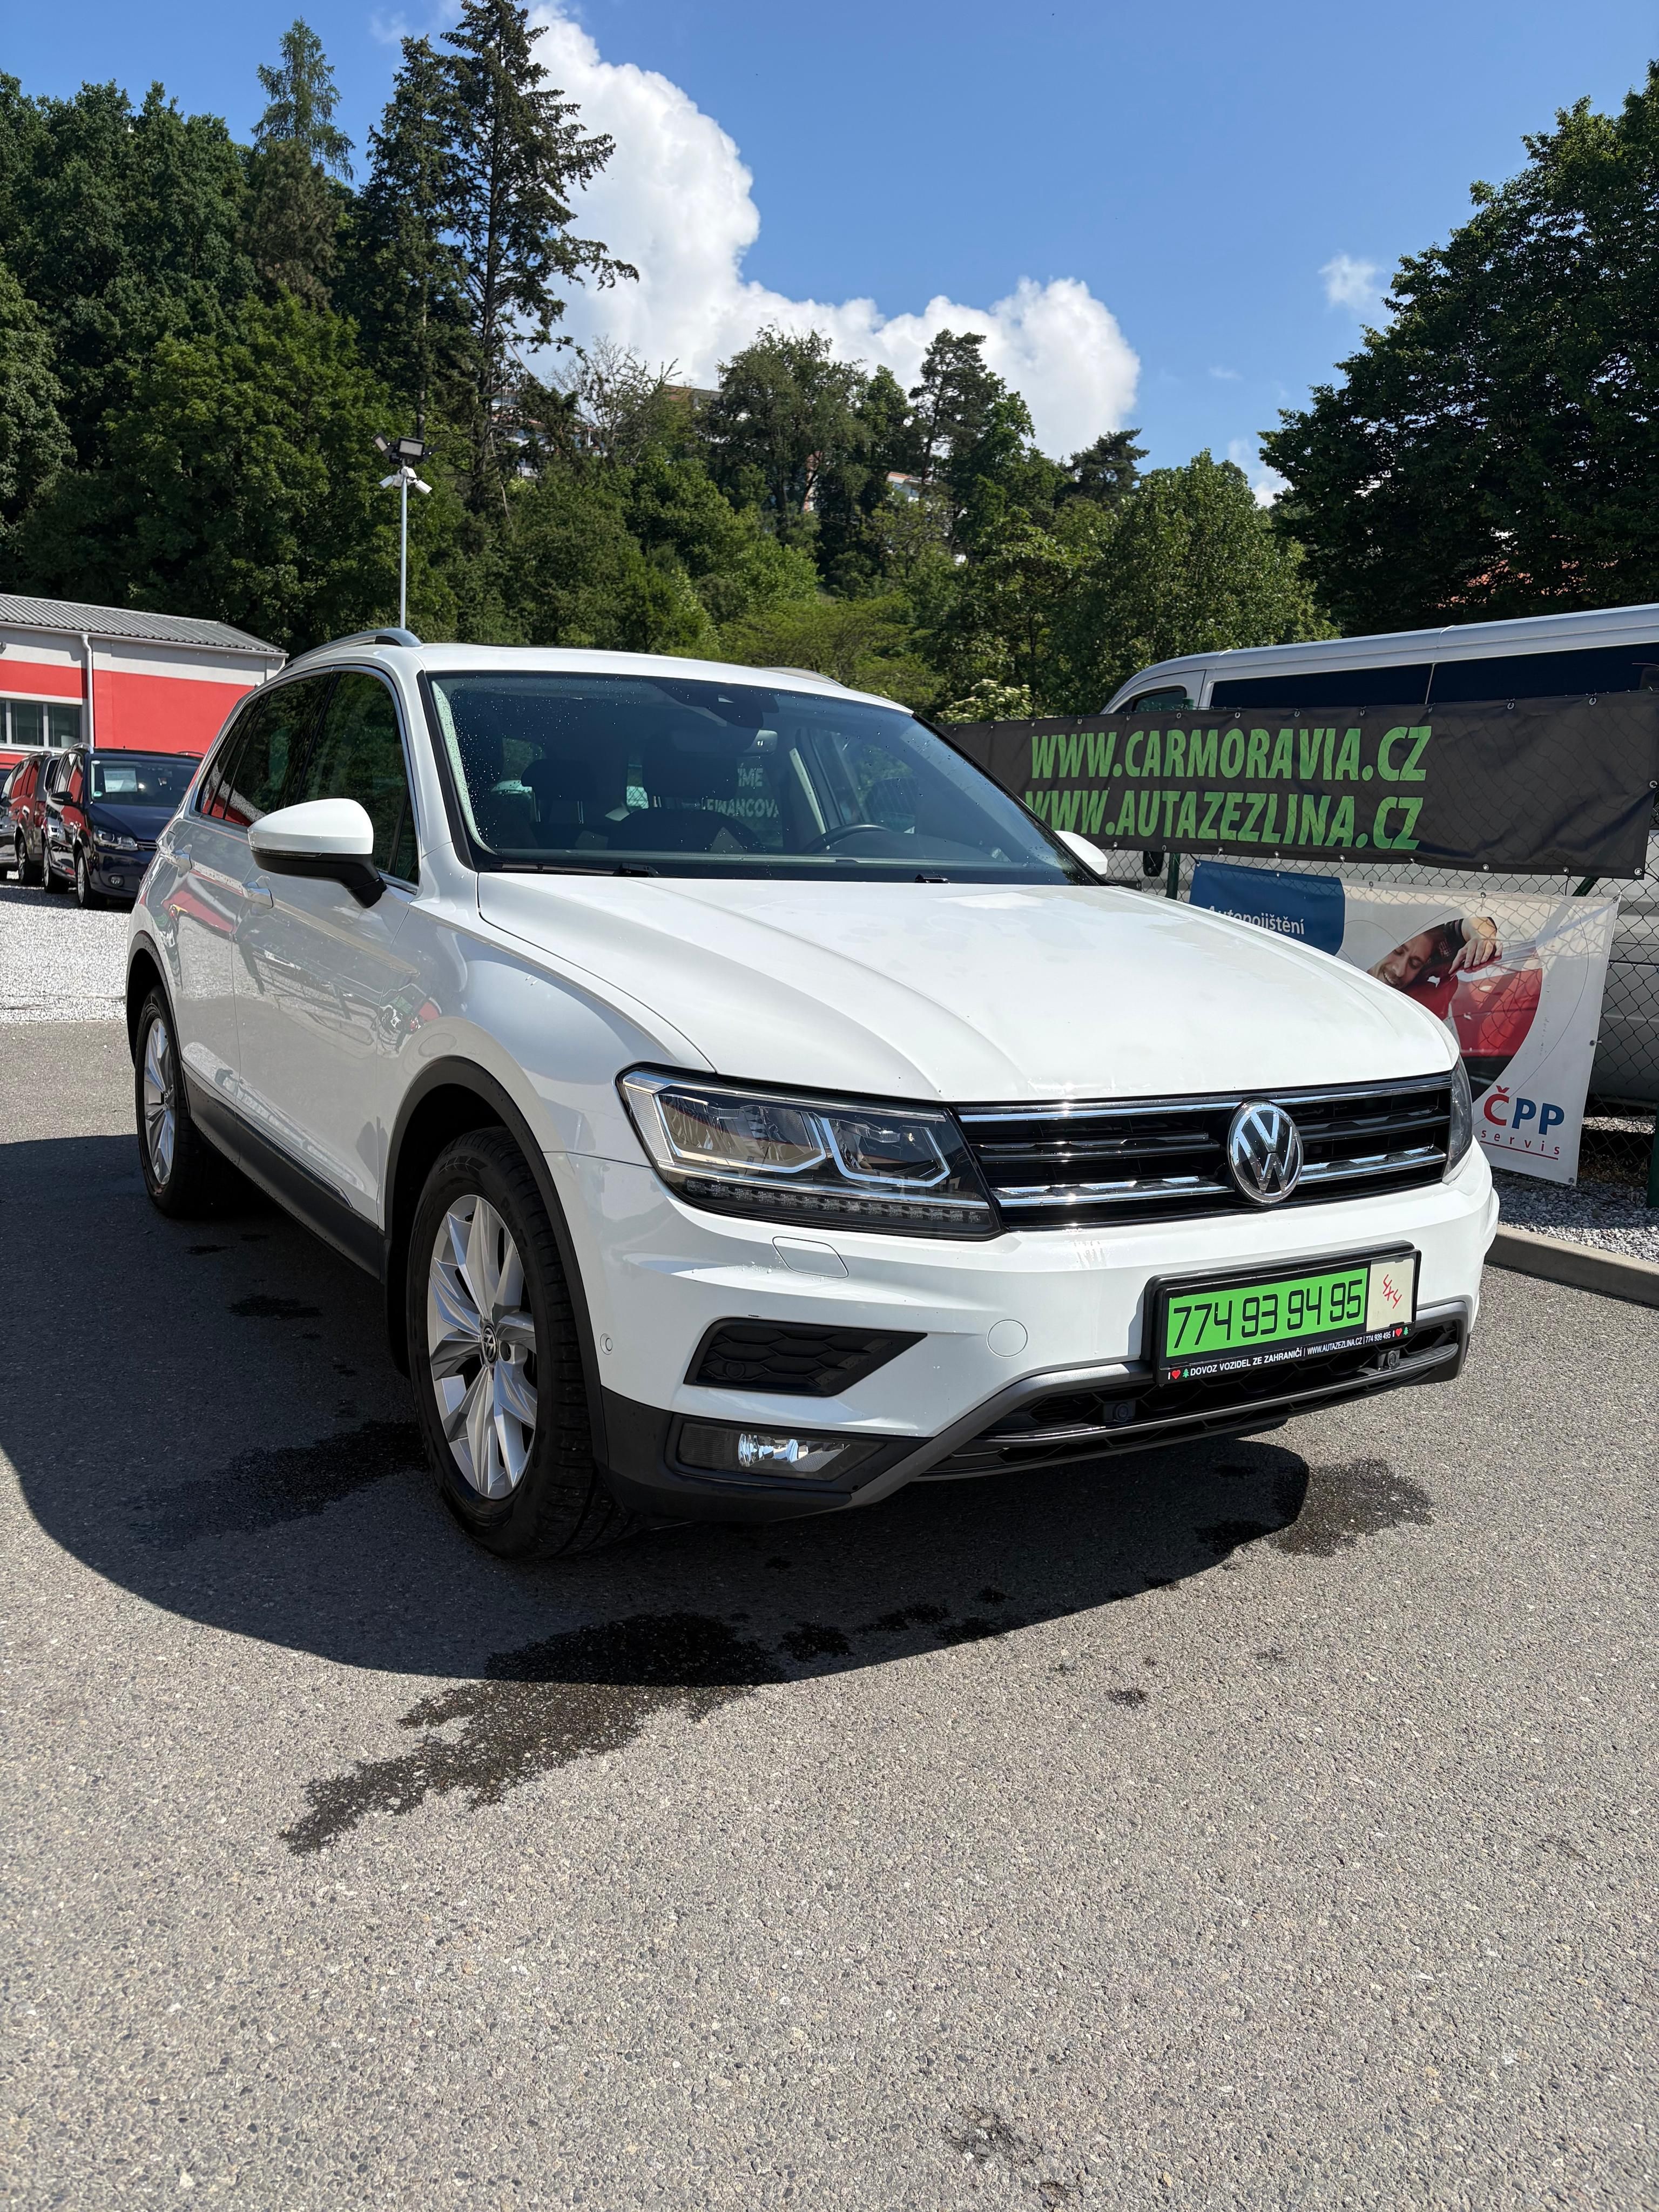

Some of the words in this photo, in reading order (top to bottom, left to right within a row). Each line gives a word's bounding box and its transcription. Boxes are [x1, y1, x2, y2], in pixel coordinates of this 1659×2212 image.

[1032, 726, 1432, 781] WWW.CARMORAVIA.CZ
[1026, 790, 1424, 849] WWW.AUTAZEZLINA.CZ
[1483, 1085, 1564, 1135] ČPP
[1481, 1130, 1560, 1155] servis
[1173, 1300, 1233, 1348] 774
[1242, 1293, 1278, 1338] 93
[1287, 1286, 1323, 1331] 94
[1330, 1279, 1363, 1323] 95
[1190, 1365, 1217, 1376] DOVOZ
[1219, 1359, 1251, 1371] VOZIDEL
[1253, 1357, 1262, 1365] ZE
[1264, 1347, 1303, 1364] ZAHRANIČÍ
[1307, 1338, 1363, 1355] WWW.AUTAZEZLINA.CZ
[1365, 1335, 1374, 1343] 774
[1374, 1333, 1382, 1341] 939
[1382, 1331, 1391, 1339] 495
